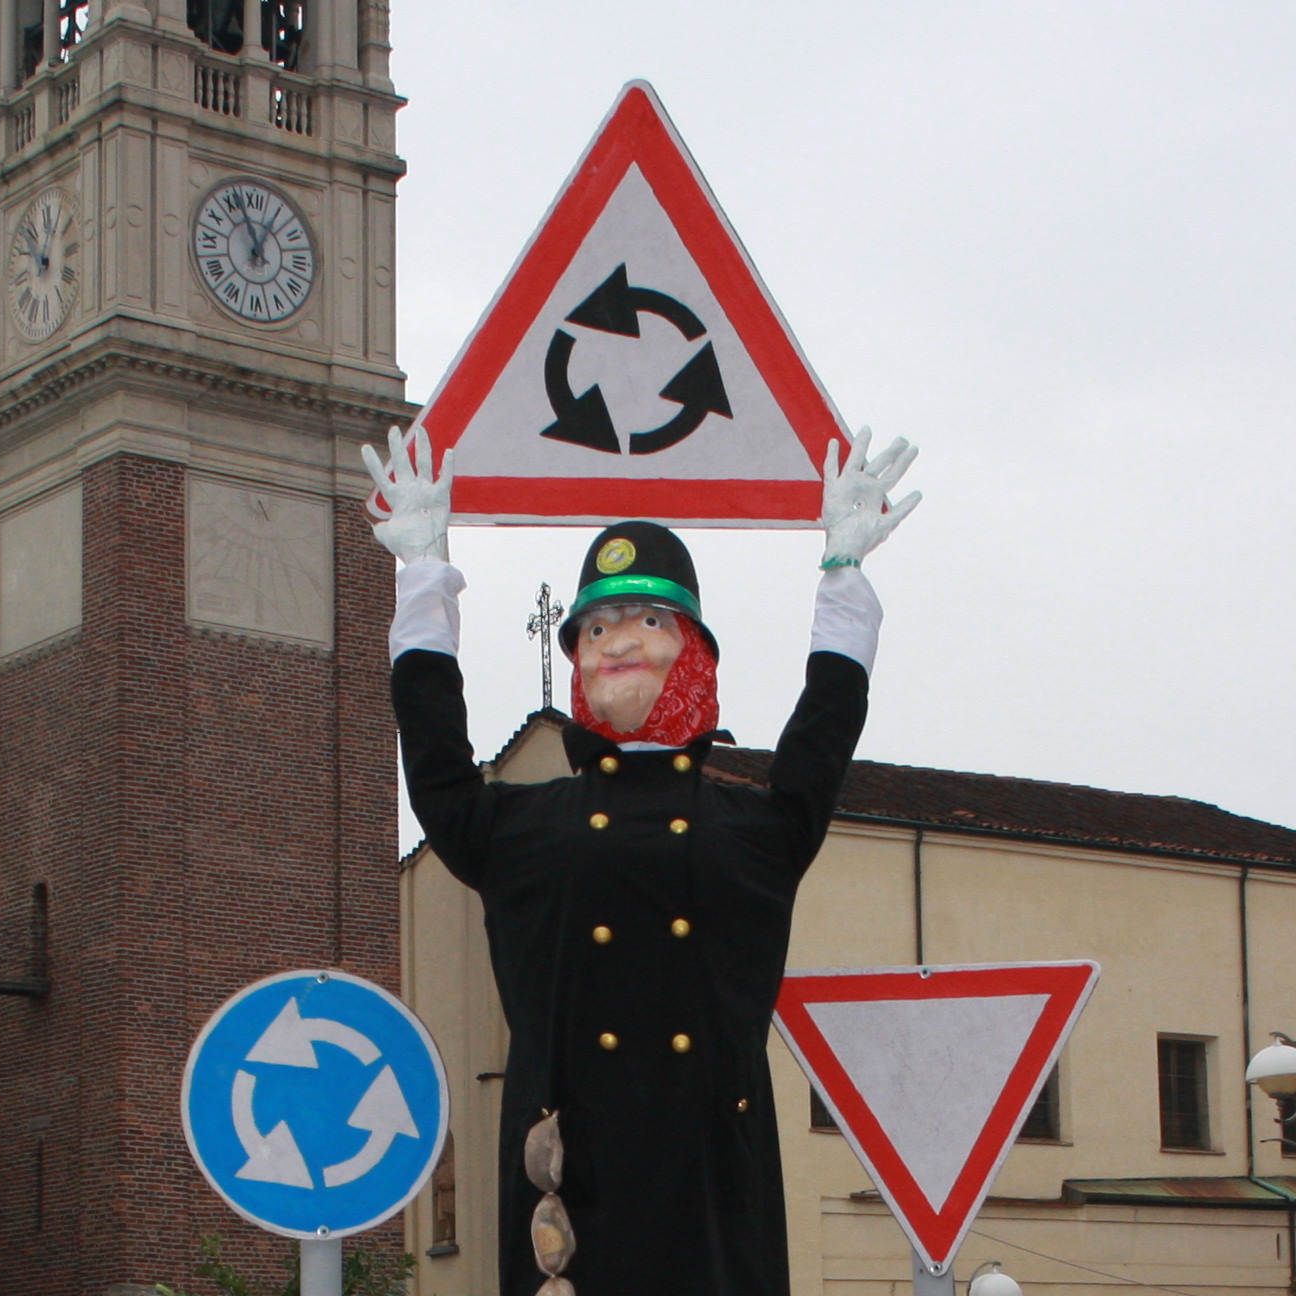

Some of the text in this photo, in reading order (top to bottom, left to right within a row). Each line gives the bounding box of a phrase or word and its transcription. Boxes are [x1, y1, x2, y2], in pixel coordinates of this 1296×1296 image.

[208, 209, 224, 226] X
[202, 232, 217, 249] IX
[292, 254, 306, 272] III
[250, 295, 262, 313] VI
